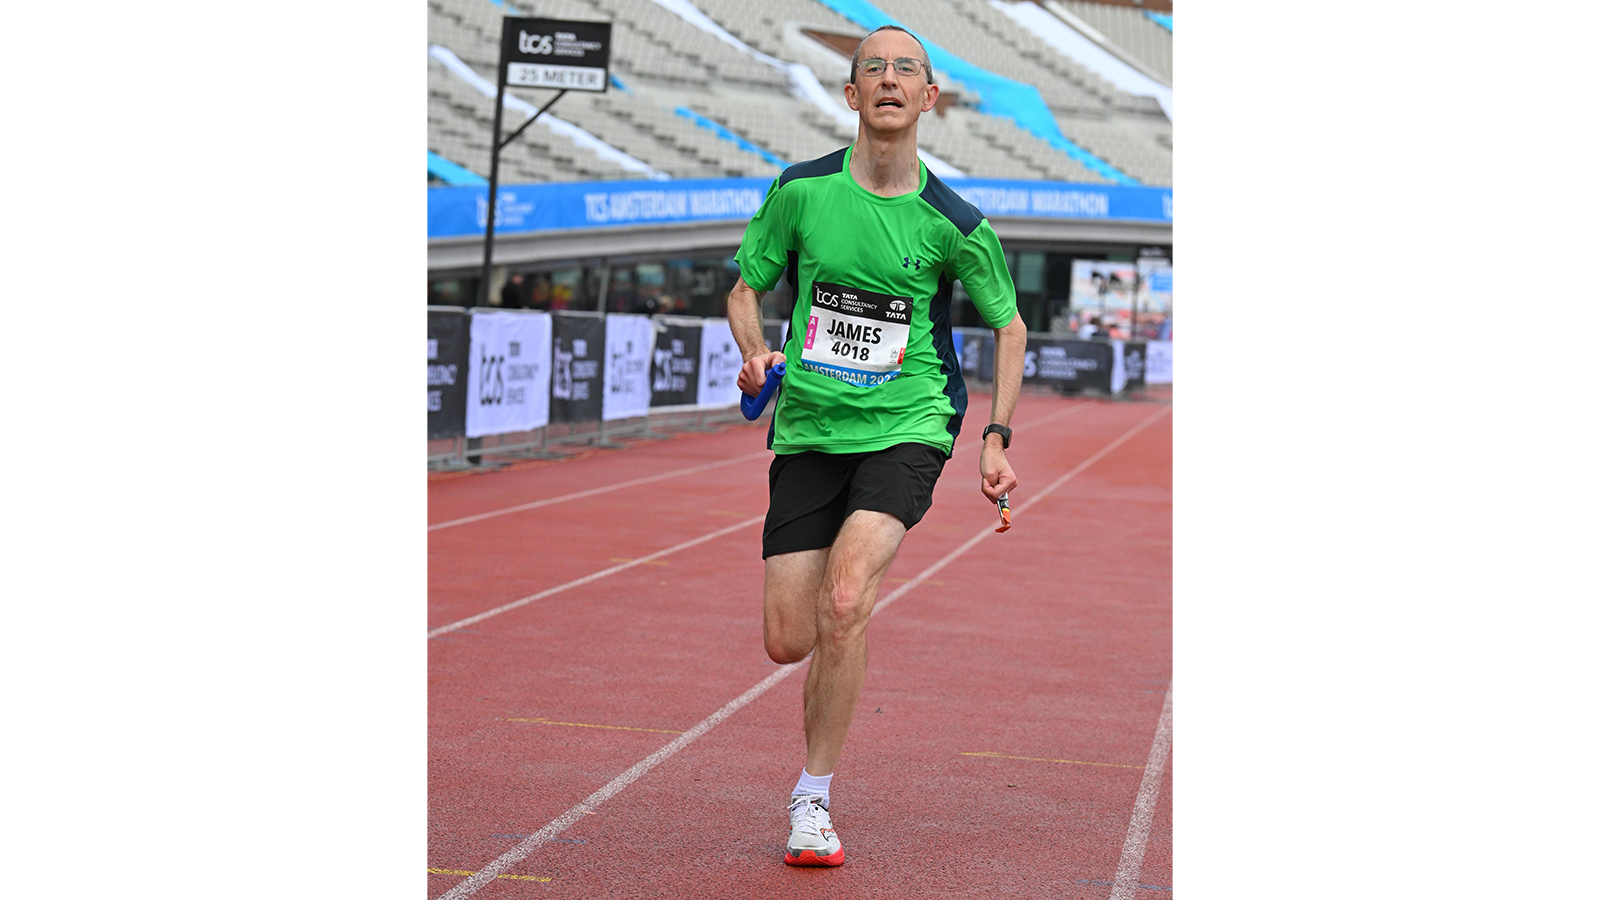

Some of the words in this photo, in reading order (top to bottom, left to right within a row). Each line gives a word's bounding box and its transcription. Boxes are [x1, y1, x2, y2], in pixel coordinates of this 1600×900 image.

[518, 29, 553, 55] tcs
[519, 67, 539, 82] 25
[543, 69, 598, 86] METER
[584, 192, 608, 222] TCS
[609, 190, 687, 220] AMSTERDAM
[689, 188, 763, 216] MARATHON
[1031, 188, 1110, 216] MARATHON
[816, 286, 839, 307] tcs
[841, 299, 878, 310] CONSULTANCY
[840, 304, 864, 313] SERVICES
[885, 311, 907, 320] TATA
[809, 317, 816, 325] A
[826, 318, 883, 345] JAMES
[831, 340, 870, 361] 4018
[803, 363, 867, 385] AMSTERDAM
[869, 374, 898, 386] 202
